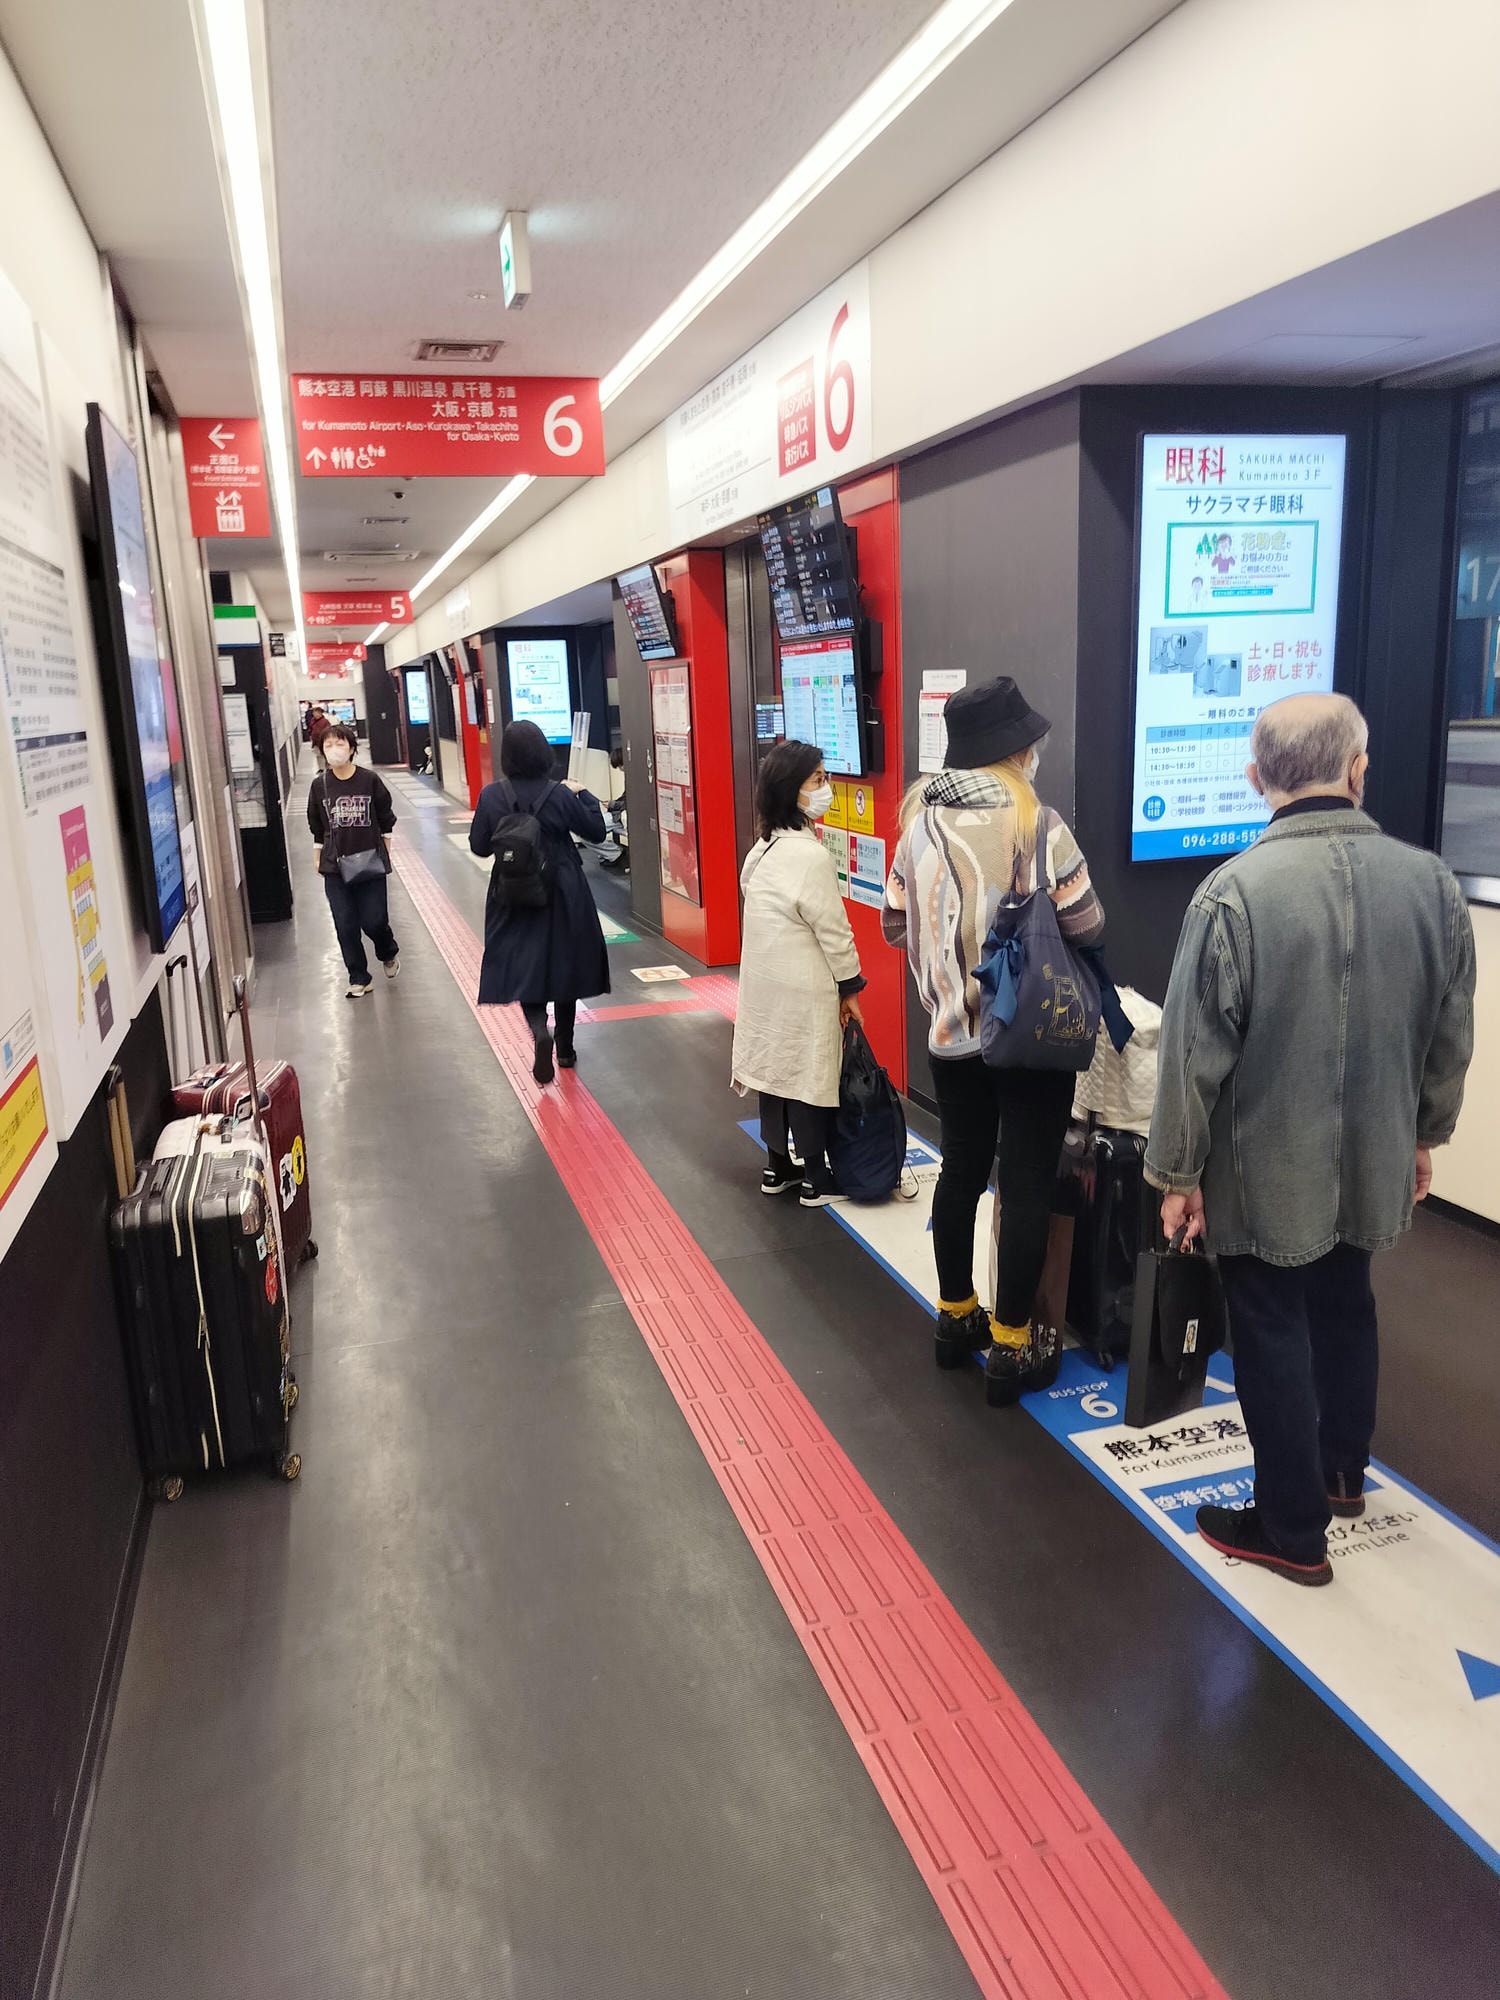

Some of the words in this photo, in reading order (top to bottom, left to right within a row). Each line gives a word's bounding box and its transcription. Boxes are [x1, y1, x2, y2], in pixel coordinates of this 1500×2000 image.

[824, 301, 854, 452] 6
[298, 379, 356, 397] 熊本空港
[359, 380, 388, 397] 阿蘇
[392, 381, 447, 398] 黒川温泉
[452, 382, 492, 398] 高千穂
[497, 387, 516, 398] 方面
[432, 401, 494, 418] 大阪・京都
[498, 405, 517, 418] 方面
[302, 419, 316, 430] for
[318, 420, 367, 431] Kumamoto
[543, 395, 583, 457] 6
[446, 432, 460, 441] for
[1165, 446, 1226, 485] 眼科
[1239, 453, 1283, 465] SAKURA
[1289, 453, 1325, 464] MACHI
[1239, 471, 1298, 481] Kumamoto
[1186, 494, 1303, 515] サクラマチ眼科
[390, 596, 406, 619] 5
[353, 645, 362, 658] 4
[1248, 640, 1322, 660] 土・日・祝も
[1049, 1387, 1077, 1399] BUS
[1076, 1380, 1108, 1395] STOP
[1080, 1393, 1118, 1418] 6
[1104, 1418, 1247, 1461] 熊本空港
[1121, 1461, 1150, 1475] For
[1152, 1443, 1247, 1470] Kumamoto
[1368, 1532, 1410, 1548] Line
